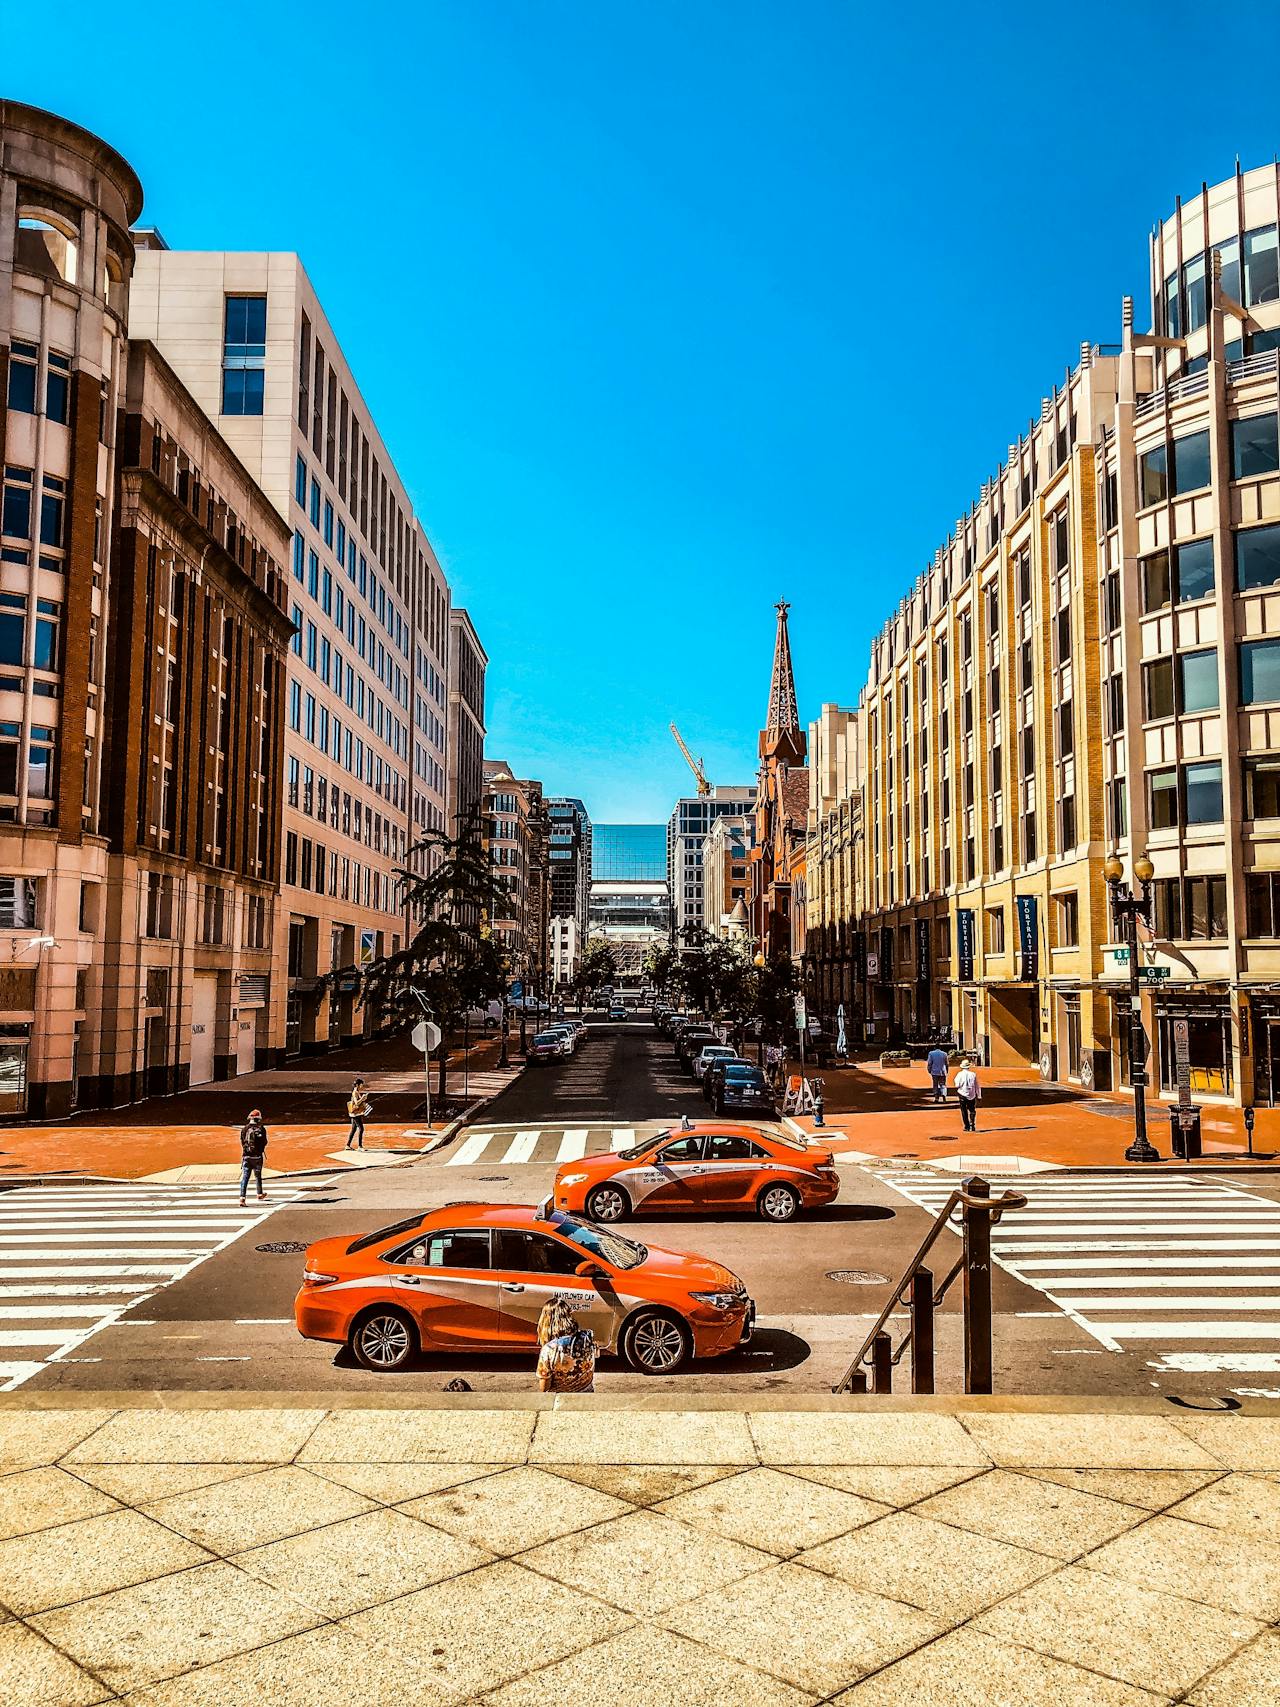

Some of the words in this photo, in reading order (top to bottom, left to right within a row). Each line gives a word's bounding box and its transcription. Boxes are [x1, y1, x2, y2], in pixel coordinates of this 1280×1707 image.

[1024, 902, 1033, 951] PORTRAIT
[920, 922, 928, 980] JETTIES
[1117, 950, 1123, 959] 8
[1147, 968, 1156, 977] G
[554, 1291, 584, 1301] MAYFLOWER
[585, 1293, 595, 1301] CAB
